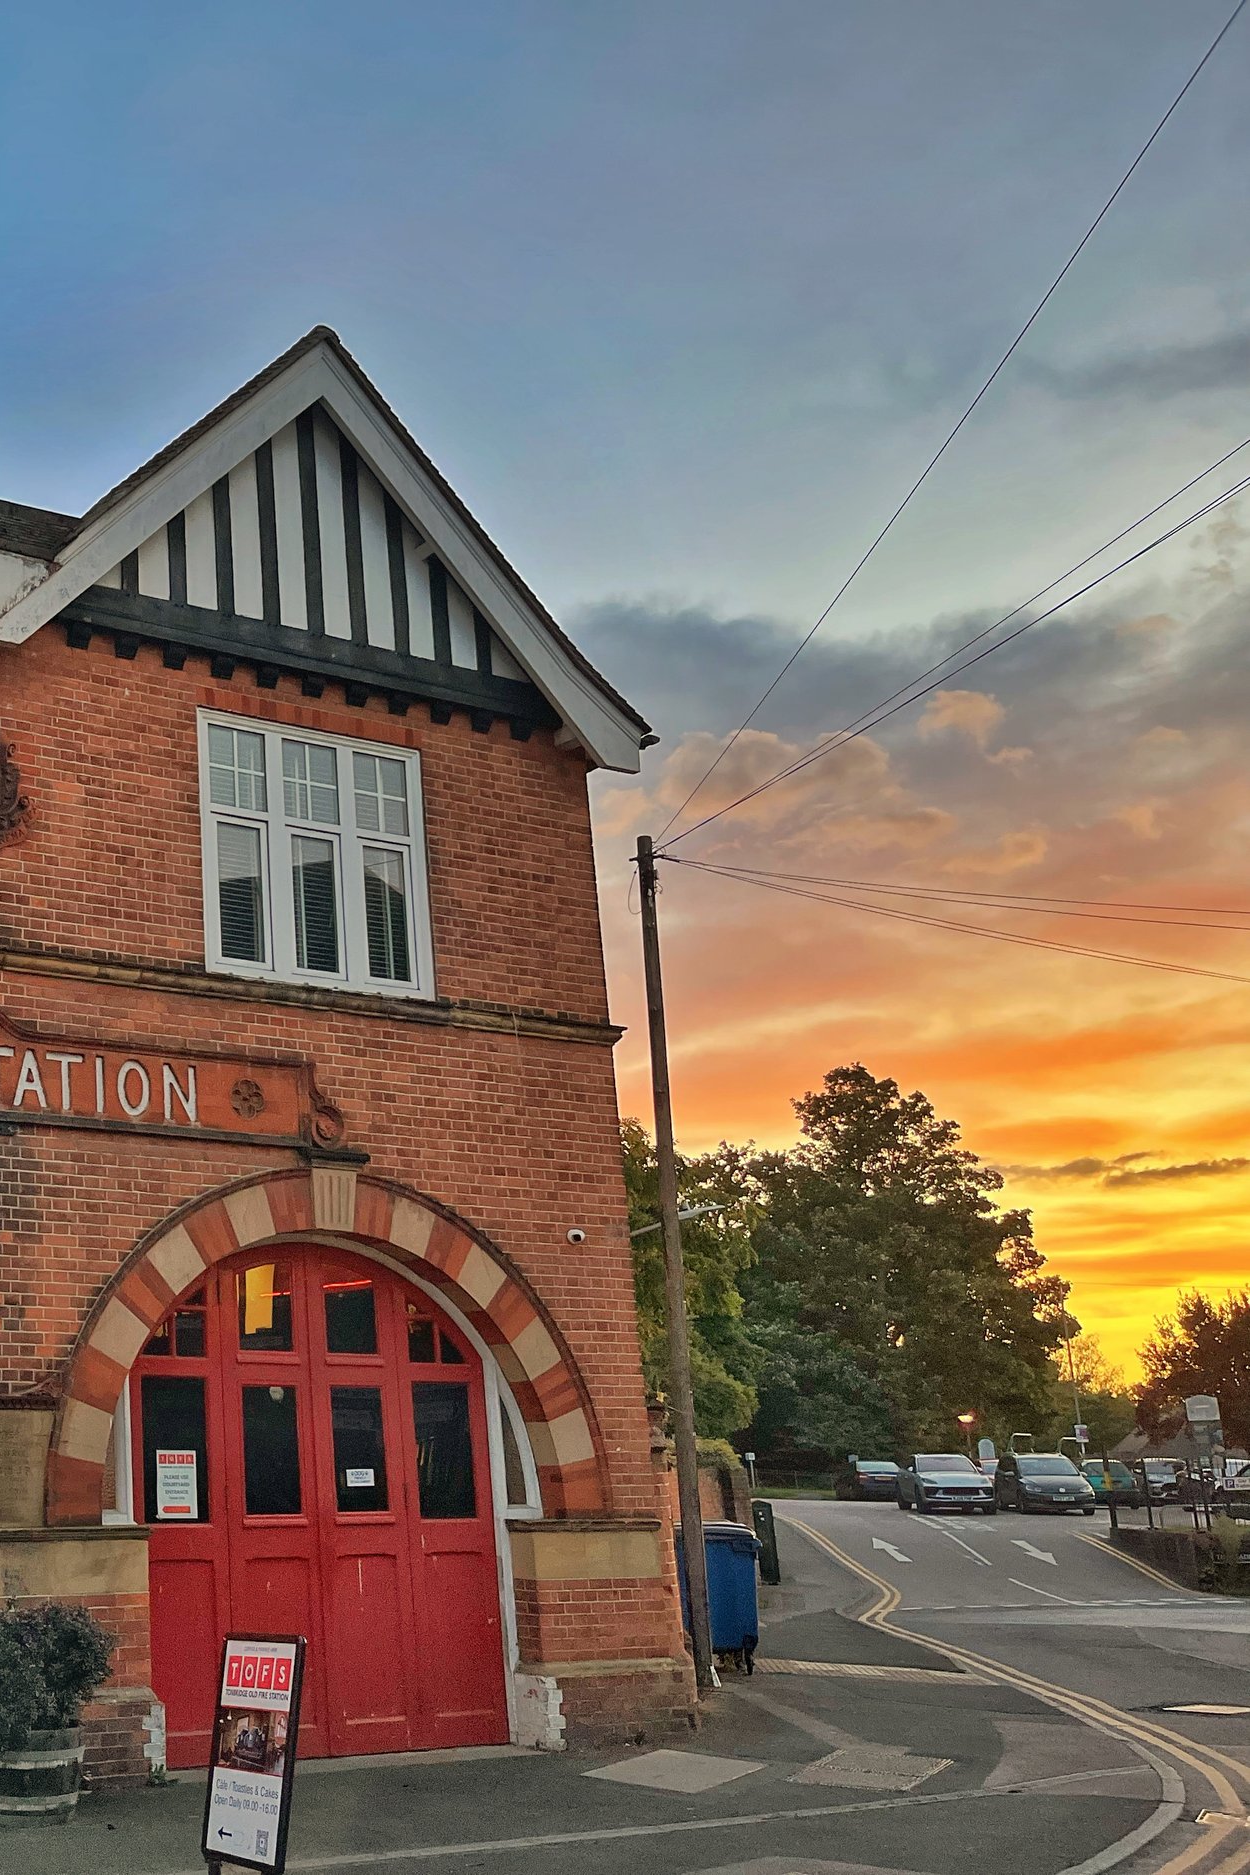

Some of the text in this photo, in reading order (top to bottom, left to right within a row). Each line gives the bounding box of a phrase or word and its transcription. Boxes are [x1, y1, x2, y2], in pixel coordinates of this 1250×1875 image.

[231, 1662, 286, 1684] TOFS
[225, 1688, 290, 1701] TONBRIDGE OLD FIRE STATION
[232, 1781, 254, 1796] Toasties
[254, 1785, 259, 1796] &
[260, 1786, 279, 1800] Cakes
[214, 1793, 228, 1806] Open
[229, 1795, 242, 1811] Daily
